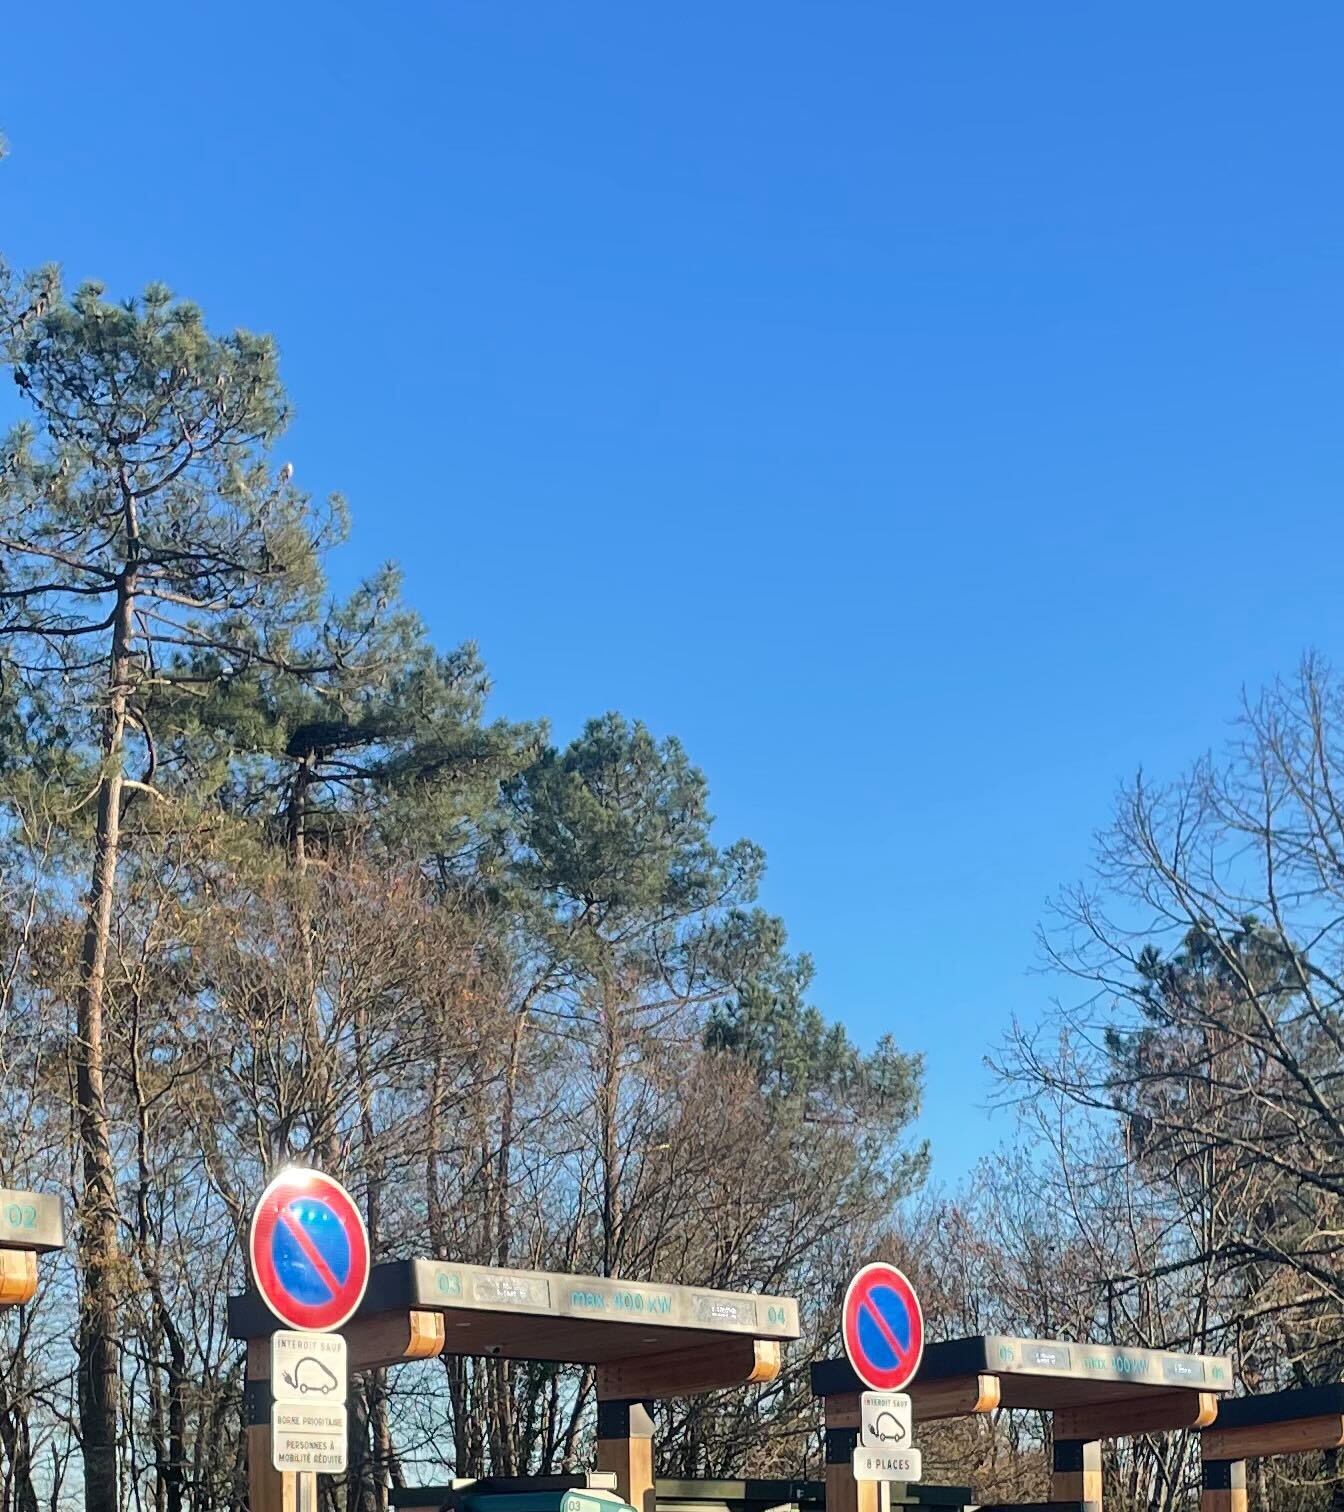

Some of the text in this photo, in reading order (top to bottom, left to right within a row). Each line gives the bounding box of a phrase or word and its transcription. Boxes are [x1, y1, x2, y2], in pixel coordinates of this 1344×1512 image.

[5, 1204, 37, 1229] 02
[436, 1272, 462, 1297] 03
[767, 1305, 785, 1325] 04
[277, 1339, 342, 1352] INTERDIT SAUF
[277, 1415, 300, 1425] BORNE
[286, 1439, 328, 1450] PERSONNES
[278, 1452, 343, 1465] MOBILITÉ RÉDUITE
[875, 1459, 910, 1470] PLACES
[568, 1501, 581, 1512] 03
